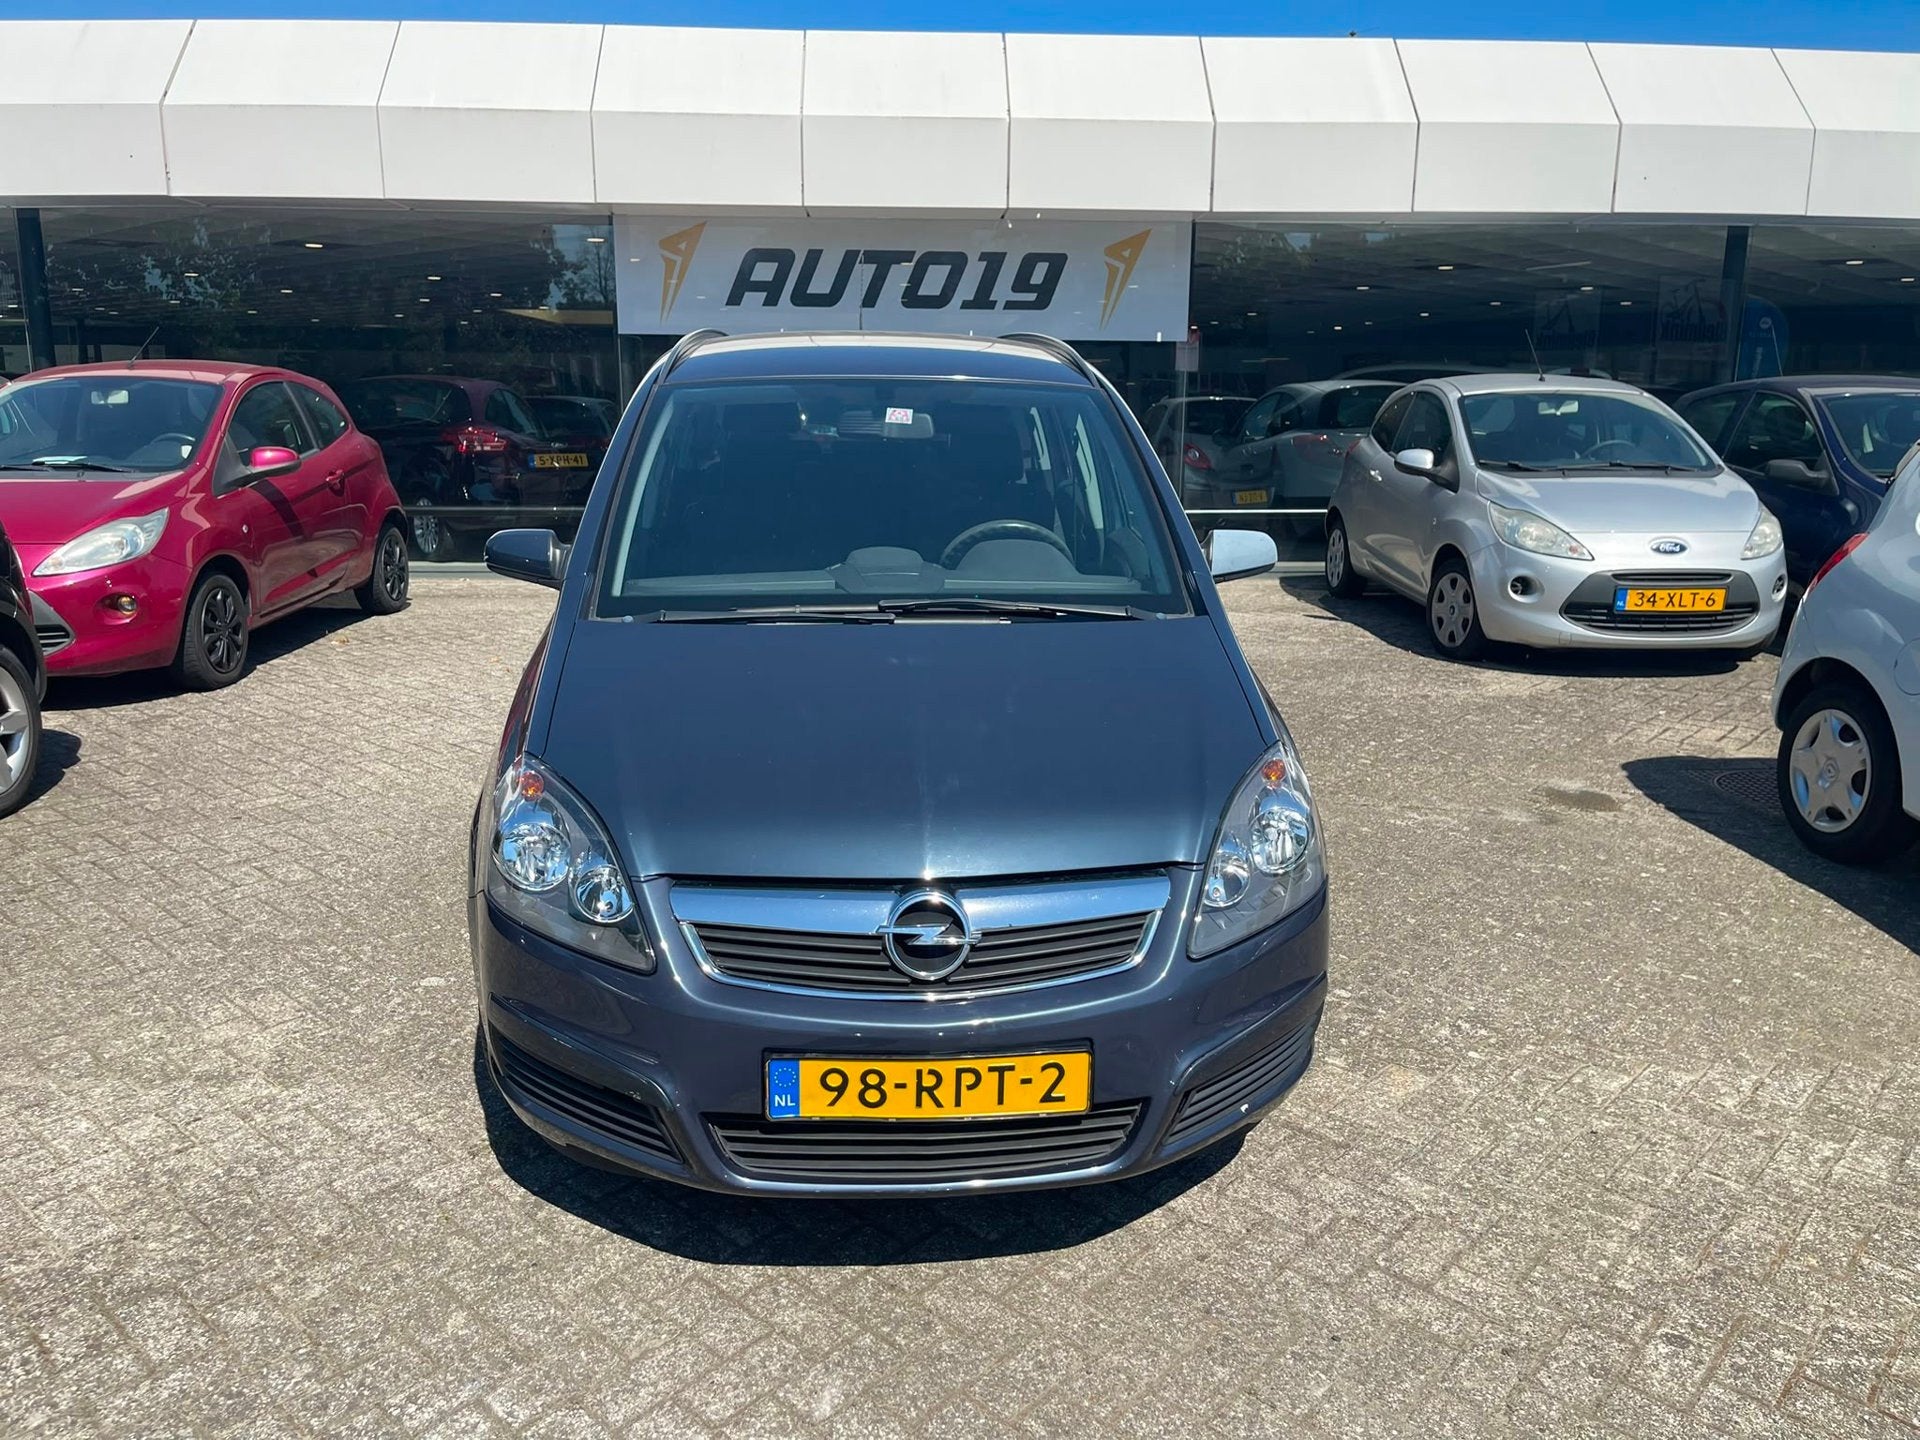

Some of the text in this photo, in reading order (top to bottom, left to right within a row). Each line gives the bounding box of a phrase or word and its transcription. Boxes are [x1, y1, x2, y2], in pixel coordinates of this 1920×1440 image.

[725, 247, 1068, 310] AUTO19
[1652, 542, 1681, 553] Ford
[1634, 591, 1716, 608] 34-XLT-6
[774, 1062, 1066, 1109] NL 98-RPT-2
